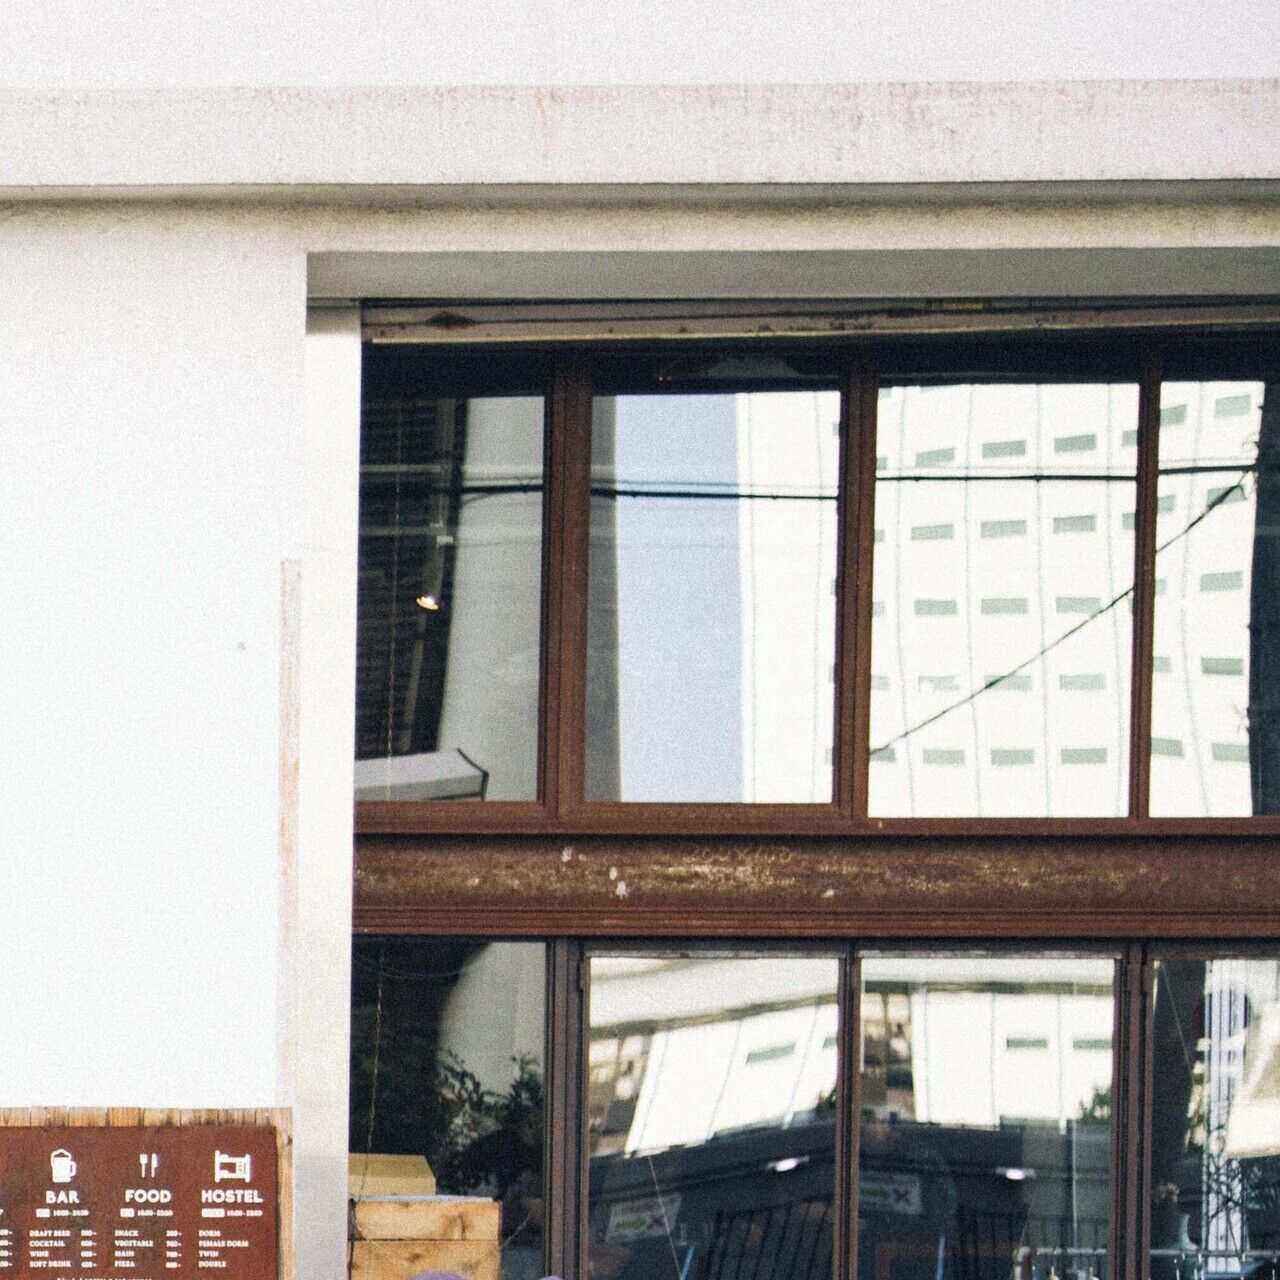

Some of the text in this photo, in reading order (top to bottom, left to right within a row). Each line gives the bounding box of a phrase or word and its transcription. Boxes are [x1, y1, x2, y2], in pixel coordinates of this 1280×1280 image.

[45, 1189, 80, 1204] BAR
[125, 1188, 171, 1203] FOOD
[201, 1188, 263, 1203] HOSTEL
[29, 1239, 65, 1247] COCKTAIL
